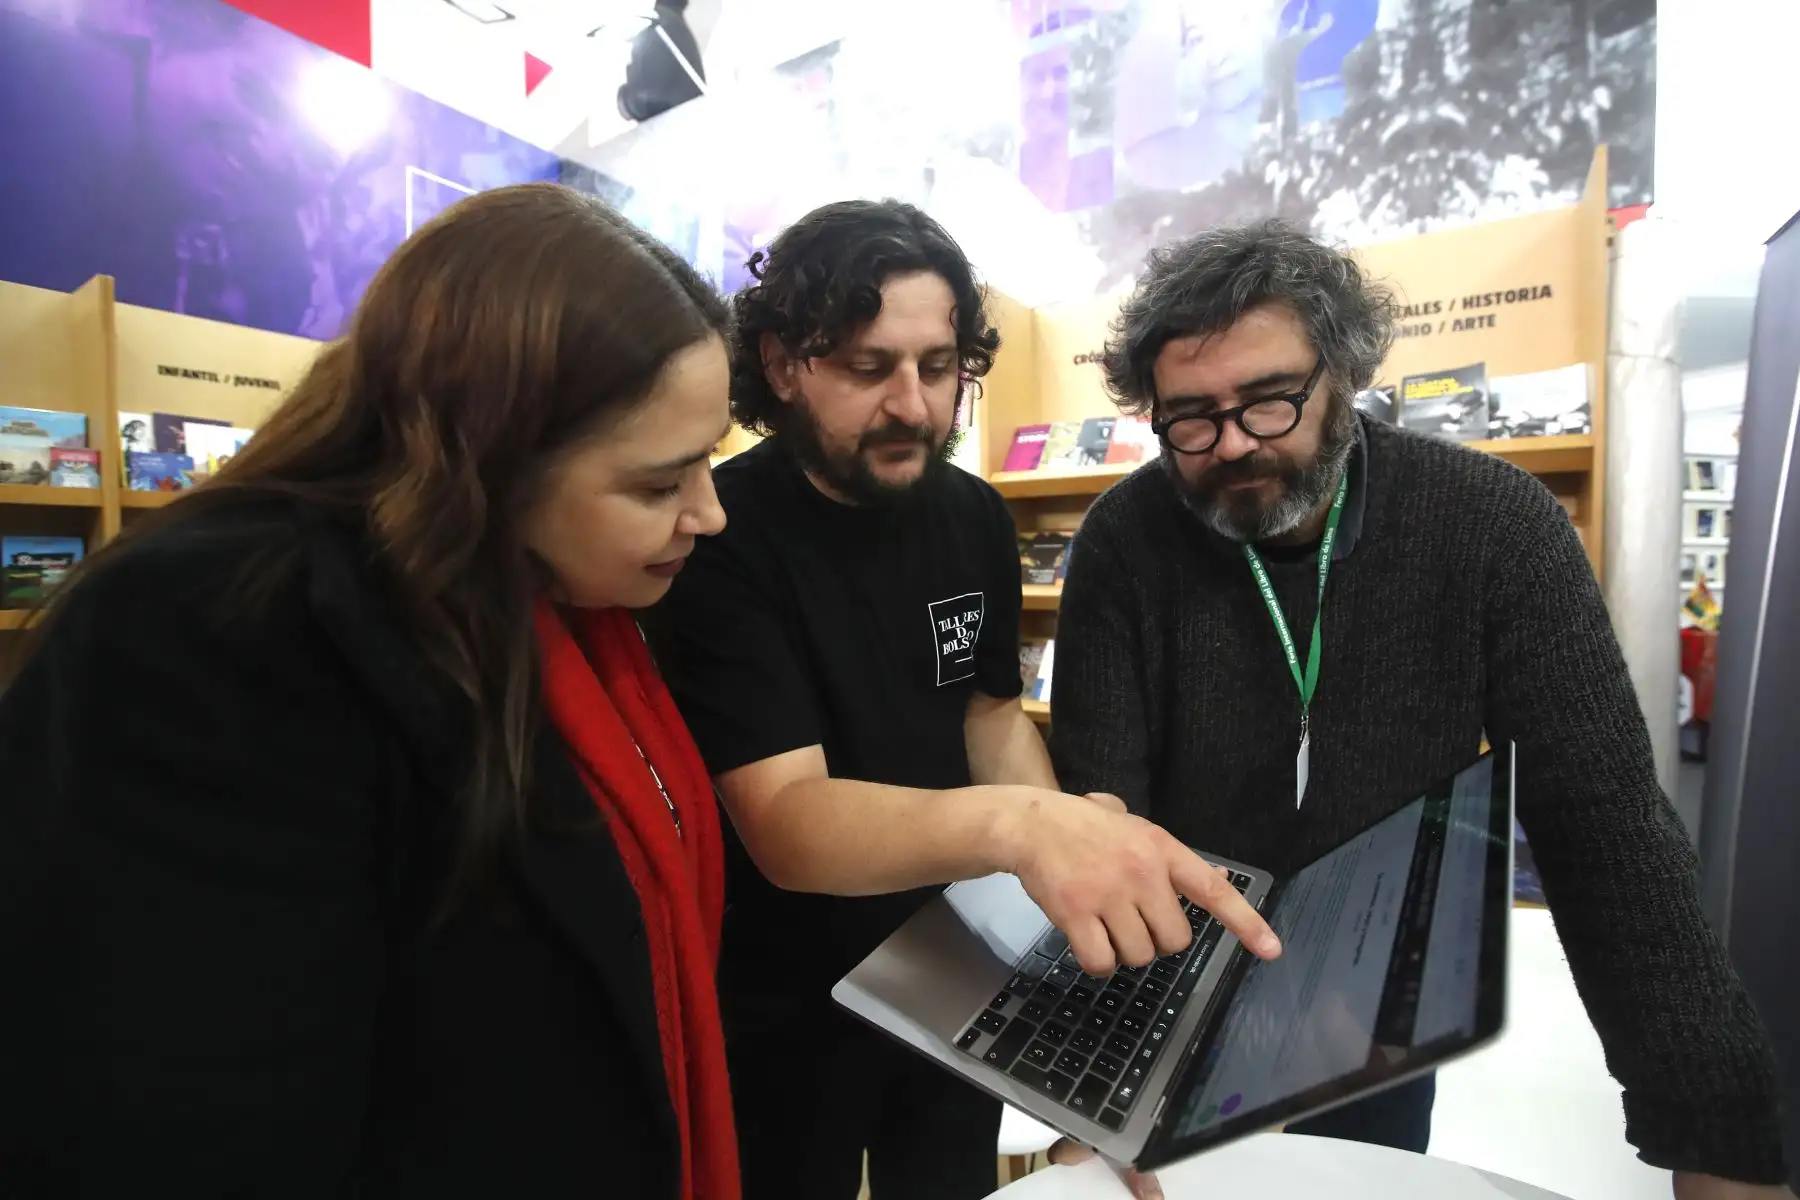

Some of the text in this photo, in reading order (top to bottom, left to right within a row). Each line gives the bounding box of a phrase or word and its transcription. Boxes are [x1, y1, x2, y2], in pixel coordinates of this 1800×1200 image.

[1462, 284, 1552, 311] HISTORIA
[1452, 314, 1497, 332] ARTE
[157, 364, 219, 383] INFANTIL
[233, 375, 281, 391] JUVENIL
[1320, 554, 1328, 573] Libro
[1258, 569, 1269, 588] Libro
